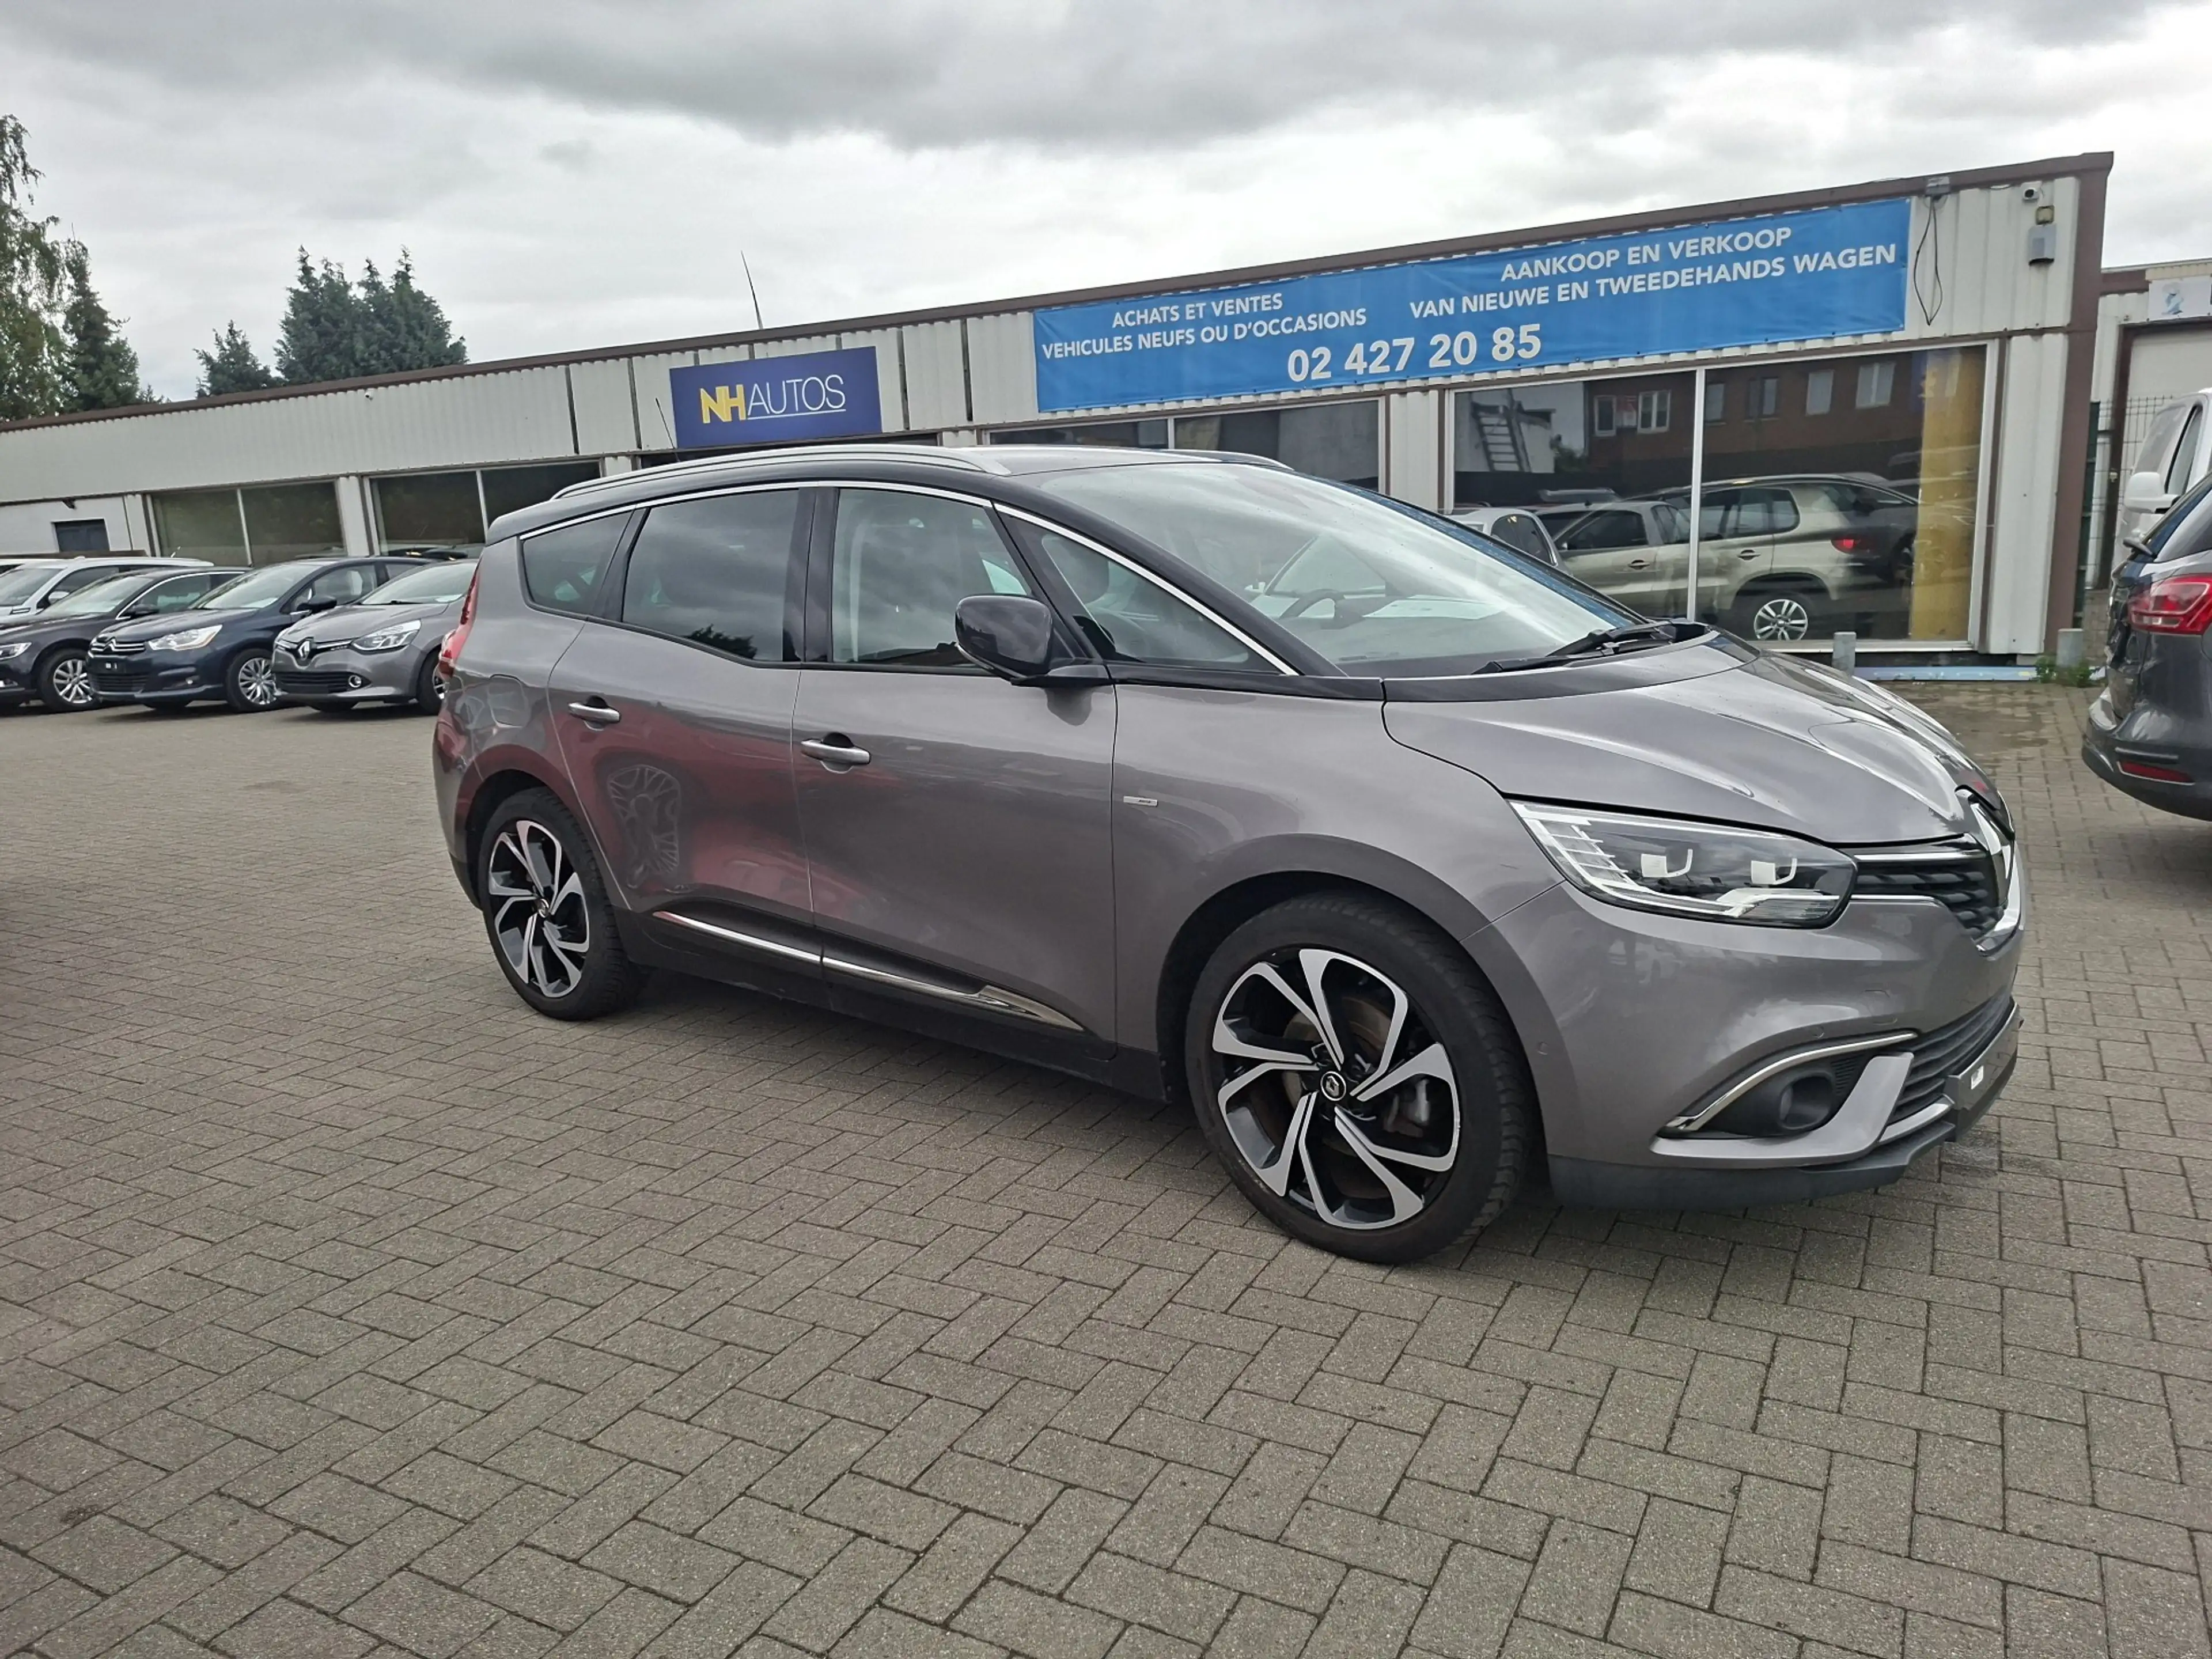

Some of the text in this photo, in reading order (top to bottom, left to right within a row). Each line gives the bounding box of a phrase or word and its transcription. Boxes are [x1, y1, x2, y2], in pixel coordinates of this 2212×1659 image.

[1409, 244, 1896, 319] VAN NIEUWE EN TWEEDEHANDS WAGEN
[1501, 227, 1791, 282] AANKOOP EN VERKOOP
[1042, 308, 1367, 359] VEHICULES NEUFS OU D'OCCASIONS
[1112, 293, 1283, 328] ACHATS ET VENTES
[1287, 323, 1541, 382] 02 427 20 85
